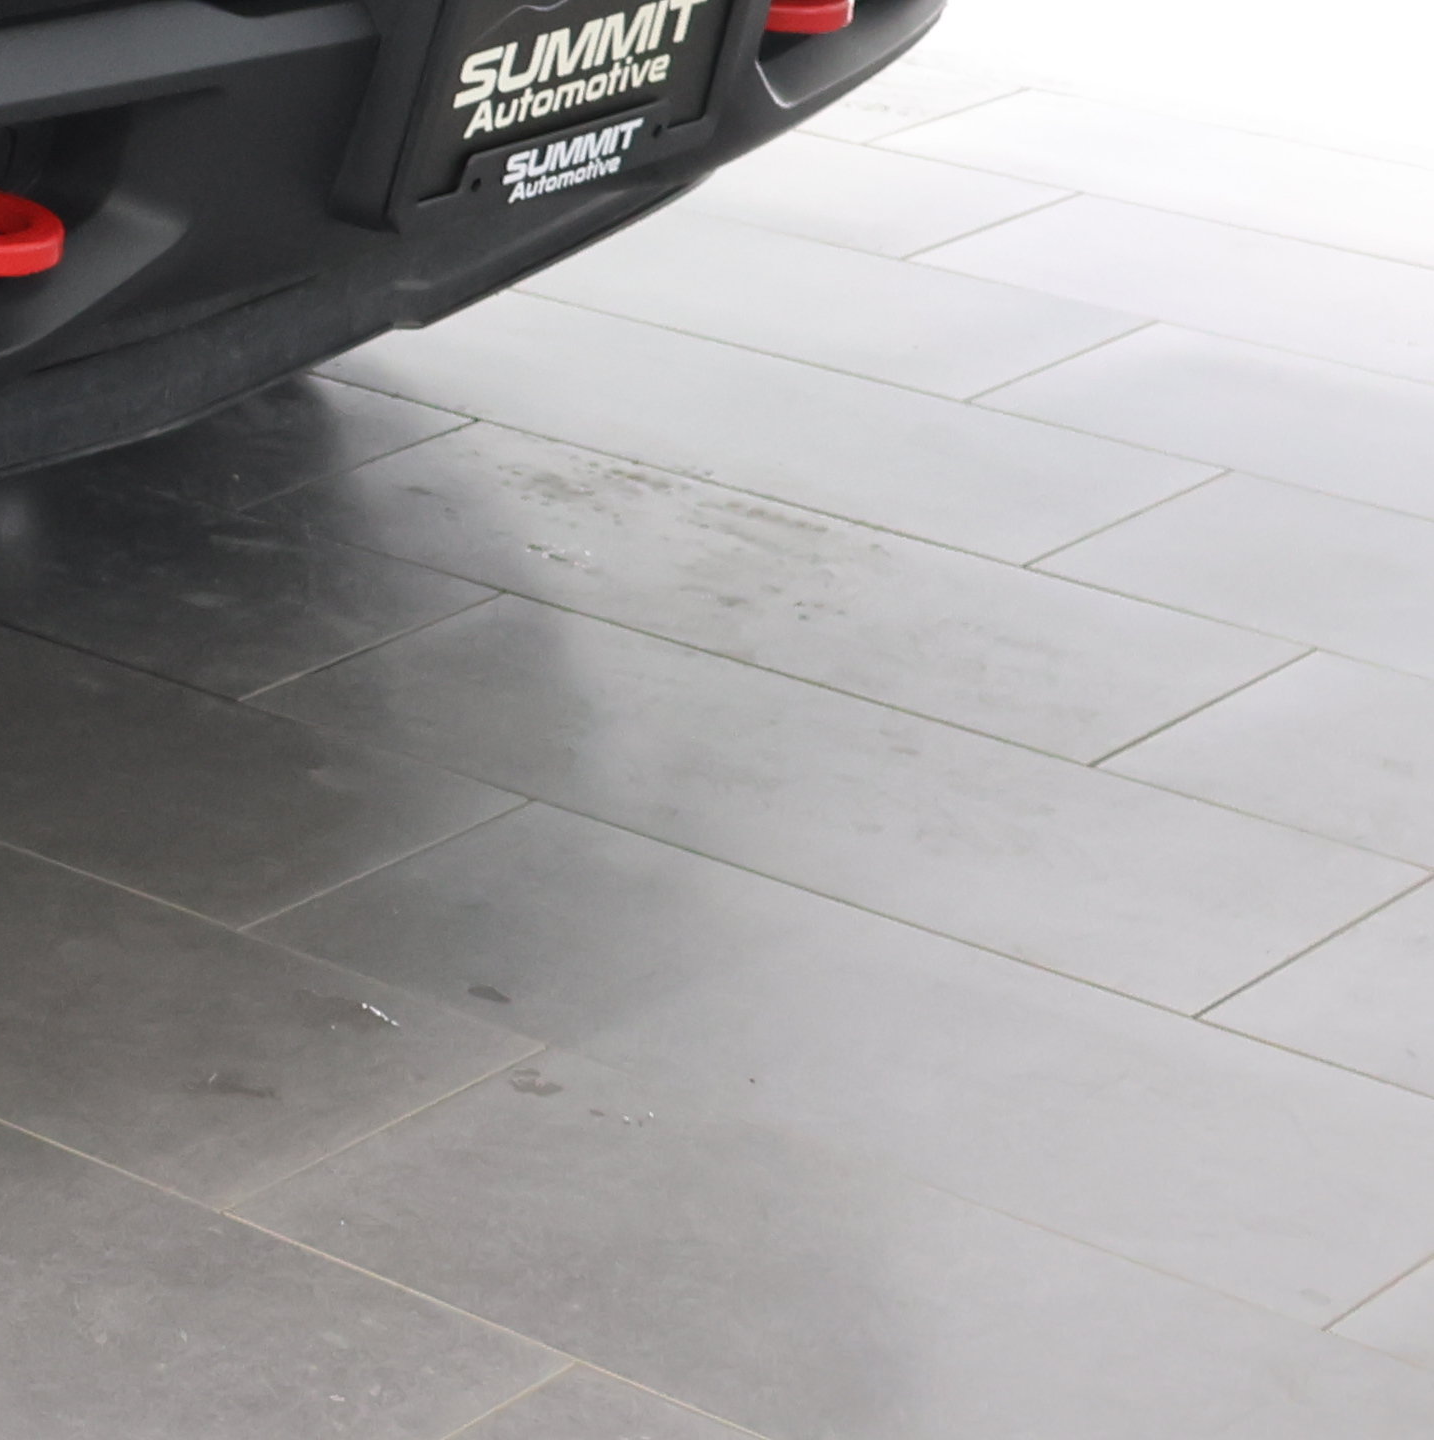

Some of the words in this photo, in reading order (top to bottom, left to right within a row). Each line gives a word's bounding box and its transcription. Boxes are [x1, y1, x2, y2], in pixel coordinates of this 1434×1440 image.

[463, 54, 671, 140] Automotive
[502, 117, 644, 185] SUMMIT
[507, 155, 622, 204] Automotive
